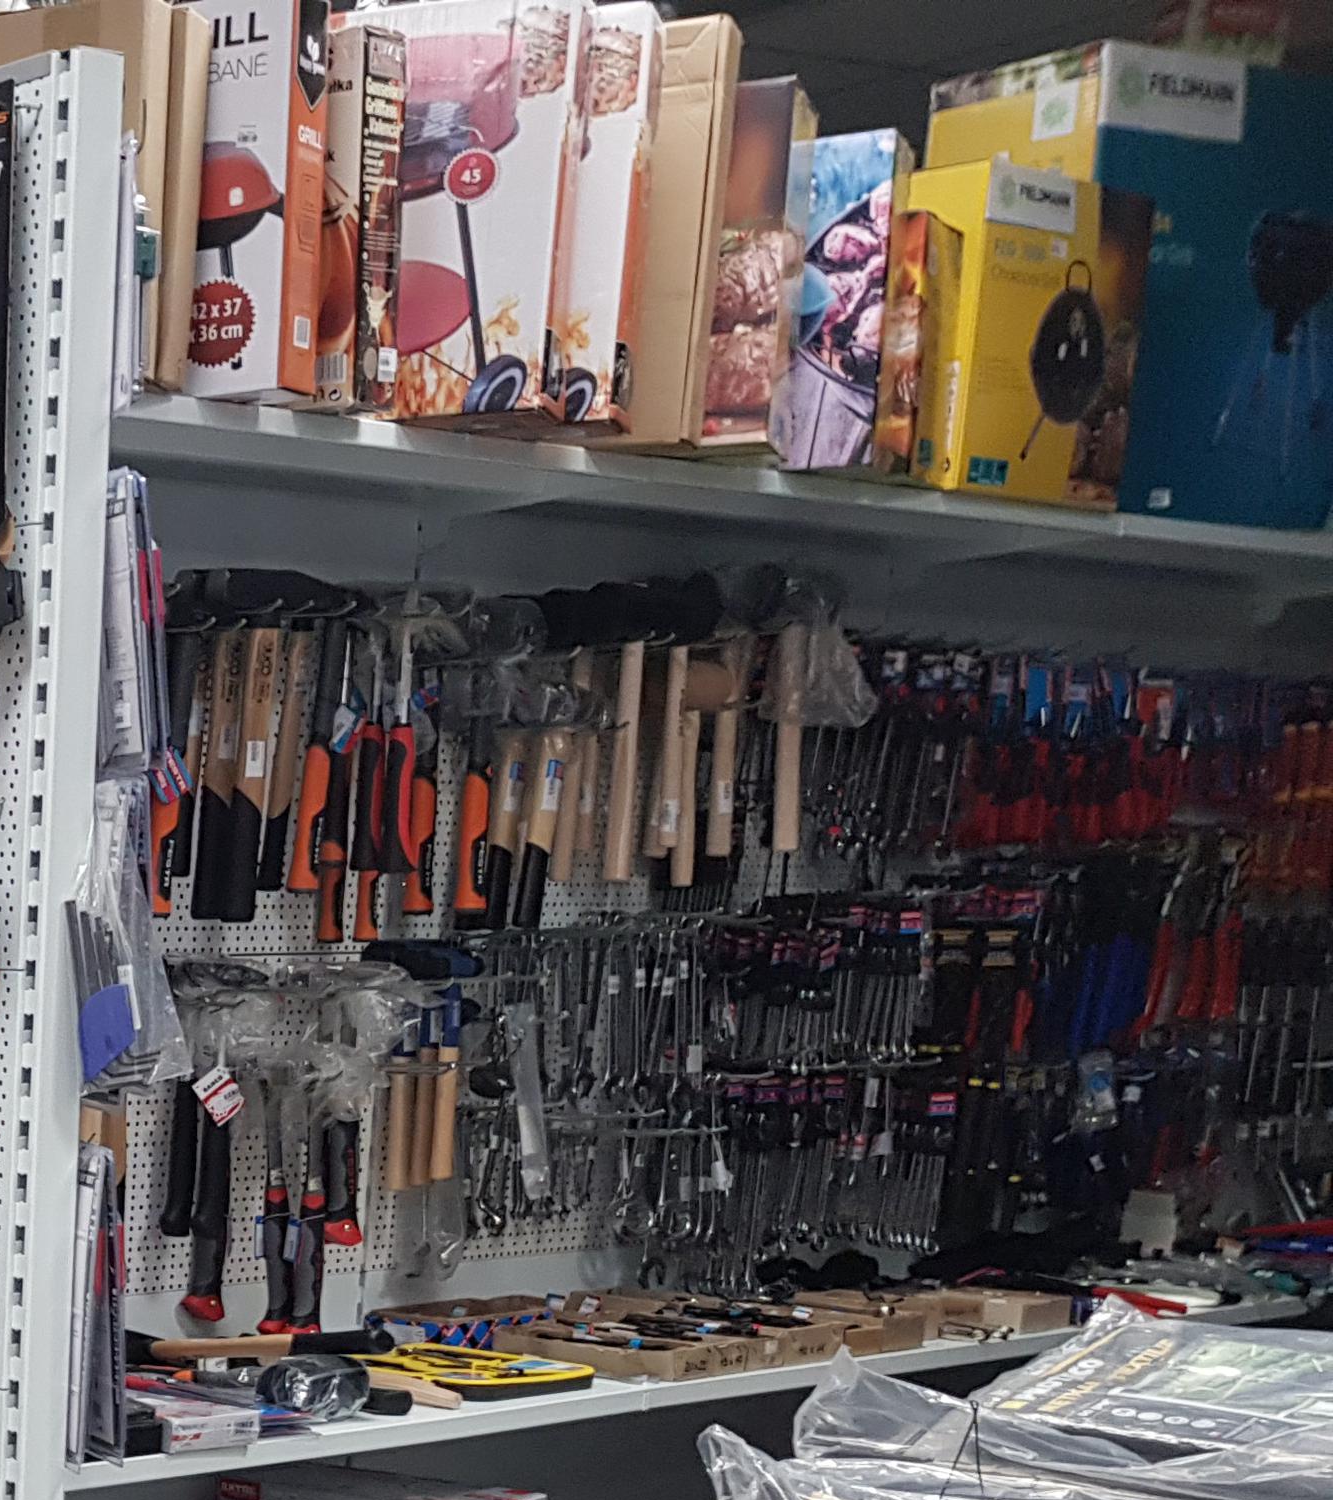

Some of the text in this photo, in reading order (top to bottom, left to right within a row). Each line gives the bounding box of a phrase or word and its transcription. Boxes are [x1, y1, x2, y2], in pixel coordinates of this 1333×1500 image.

[213, 11, 270, 49] ILL
[222, 298, 243, 316] 37
[198, 325, 219, 343] 36
[220, 324, 244, 341] cm
